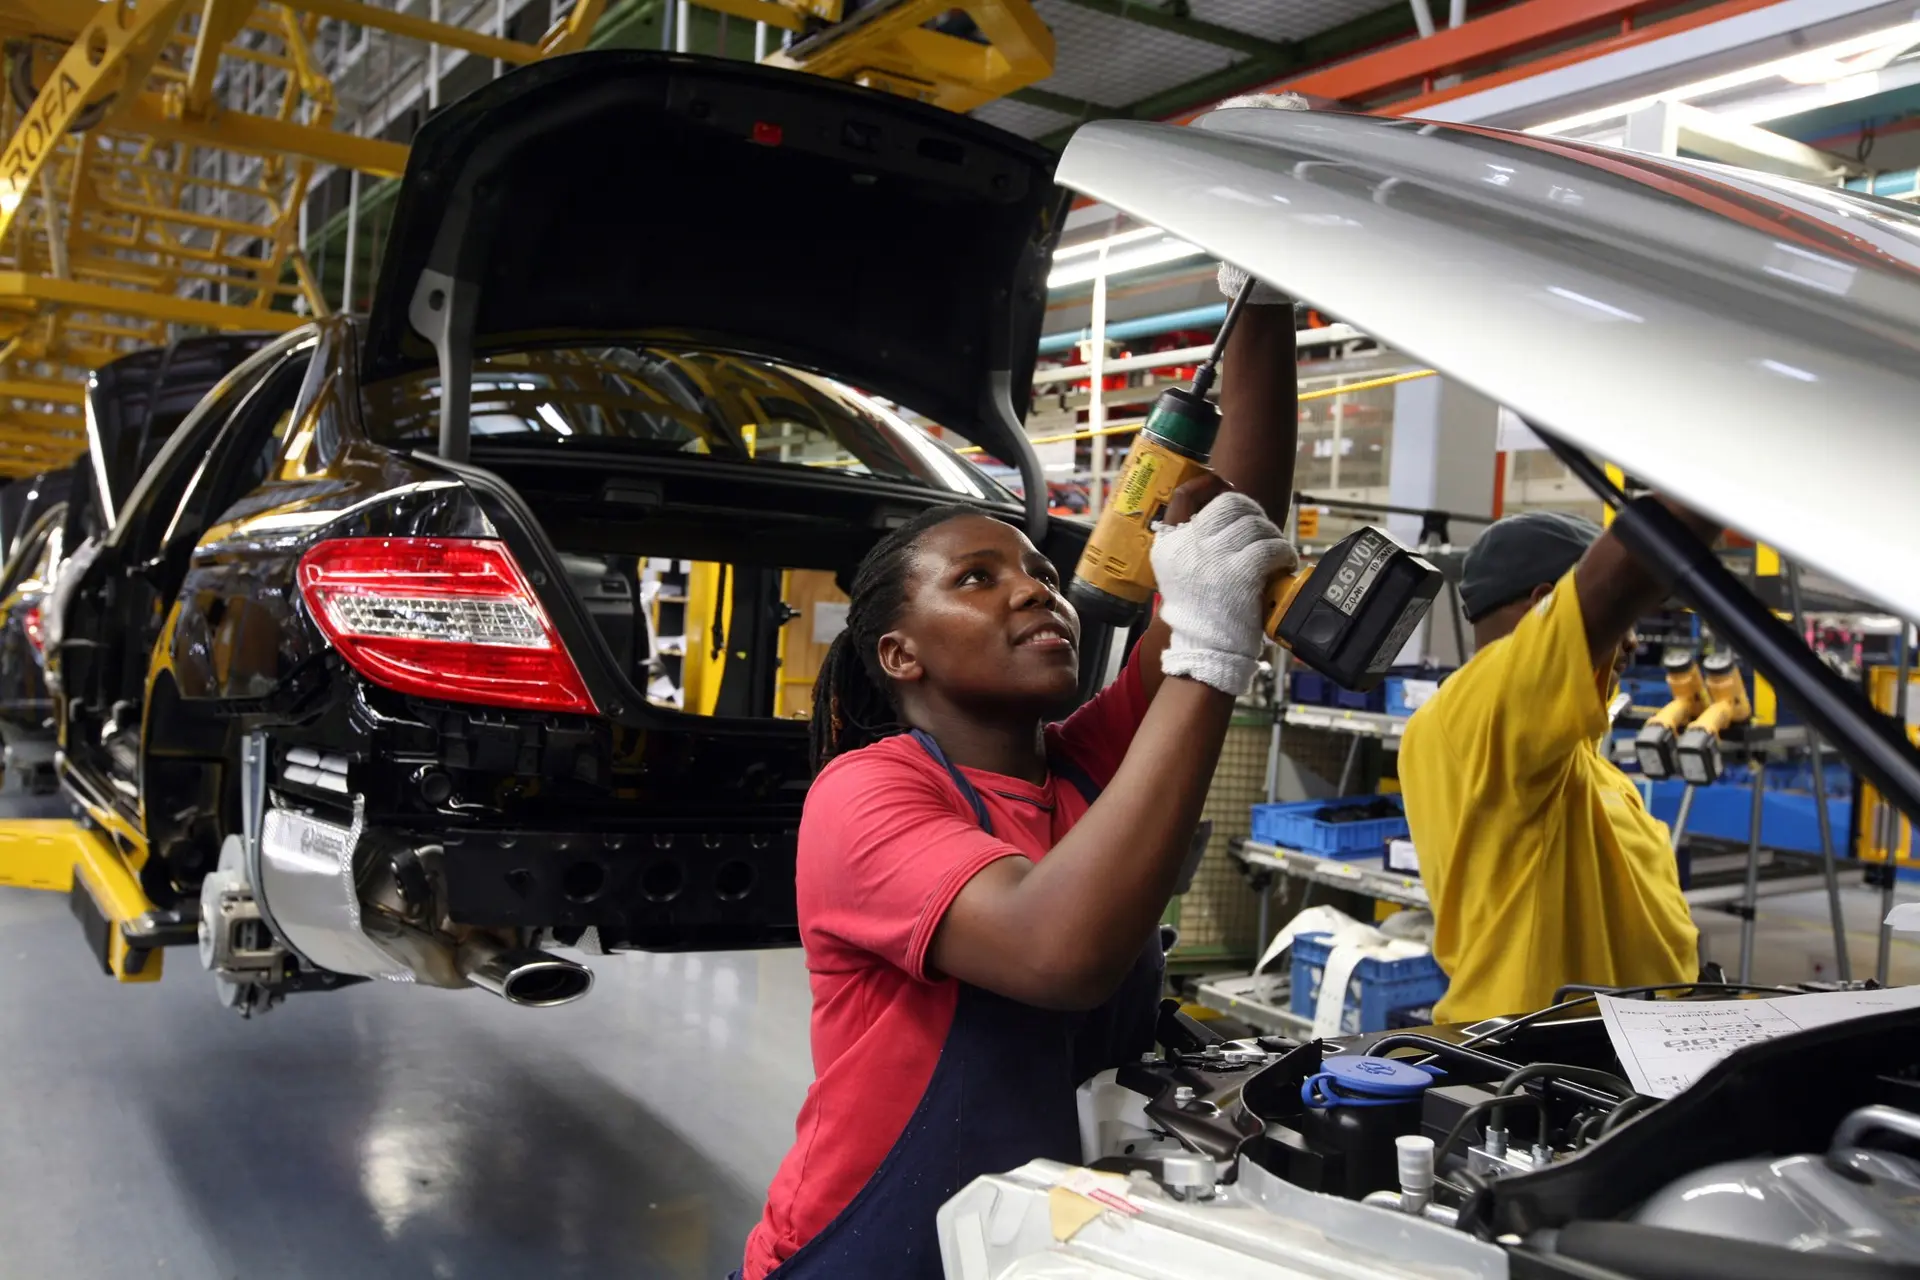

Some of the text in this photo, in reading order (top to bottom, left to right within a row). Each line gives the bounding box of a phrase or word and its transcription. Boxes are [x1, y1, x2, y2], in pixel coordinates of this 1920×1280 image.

[4, 71, 80, 191] ROFA
[1327, 532, 1382, 601] 9.6 VOLT
